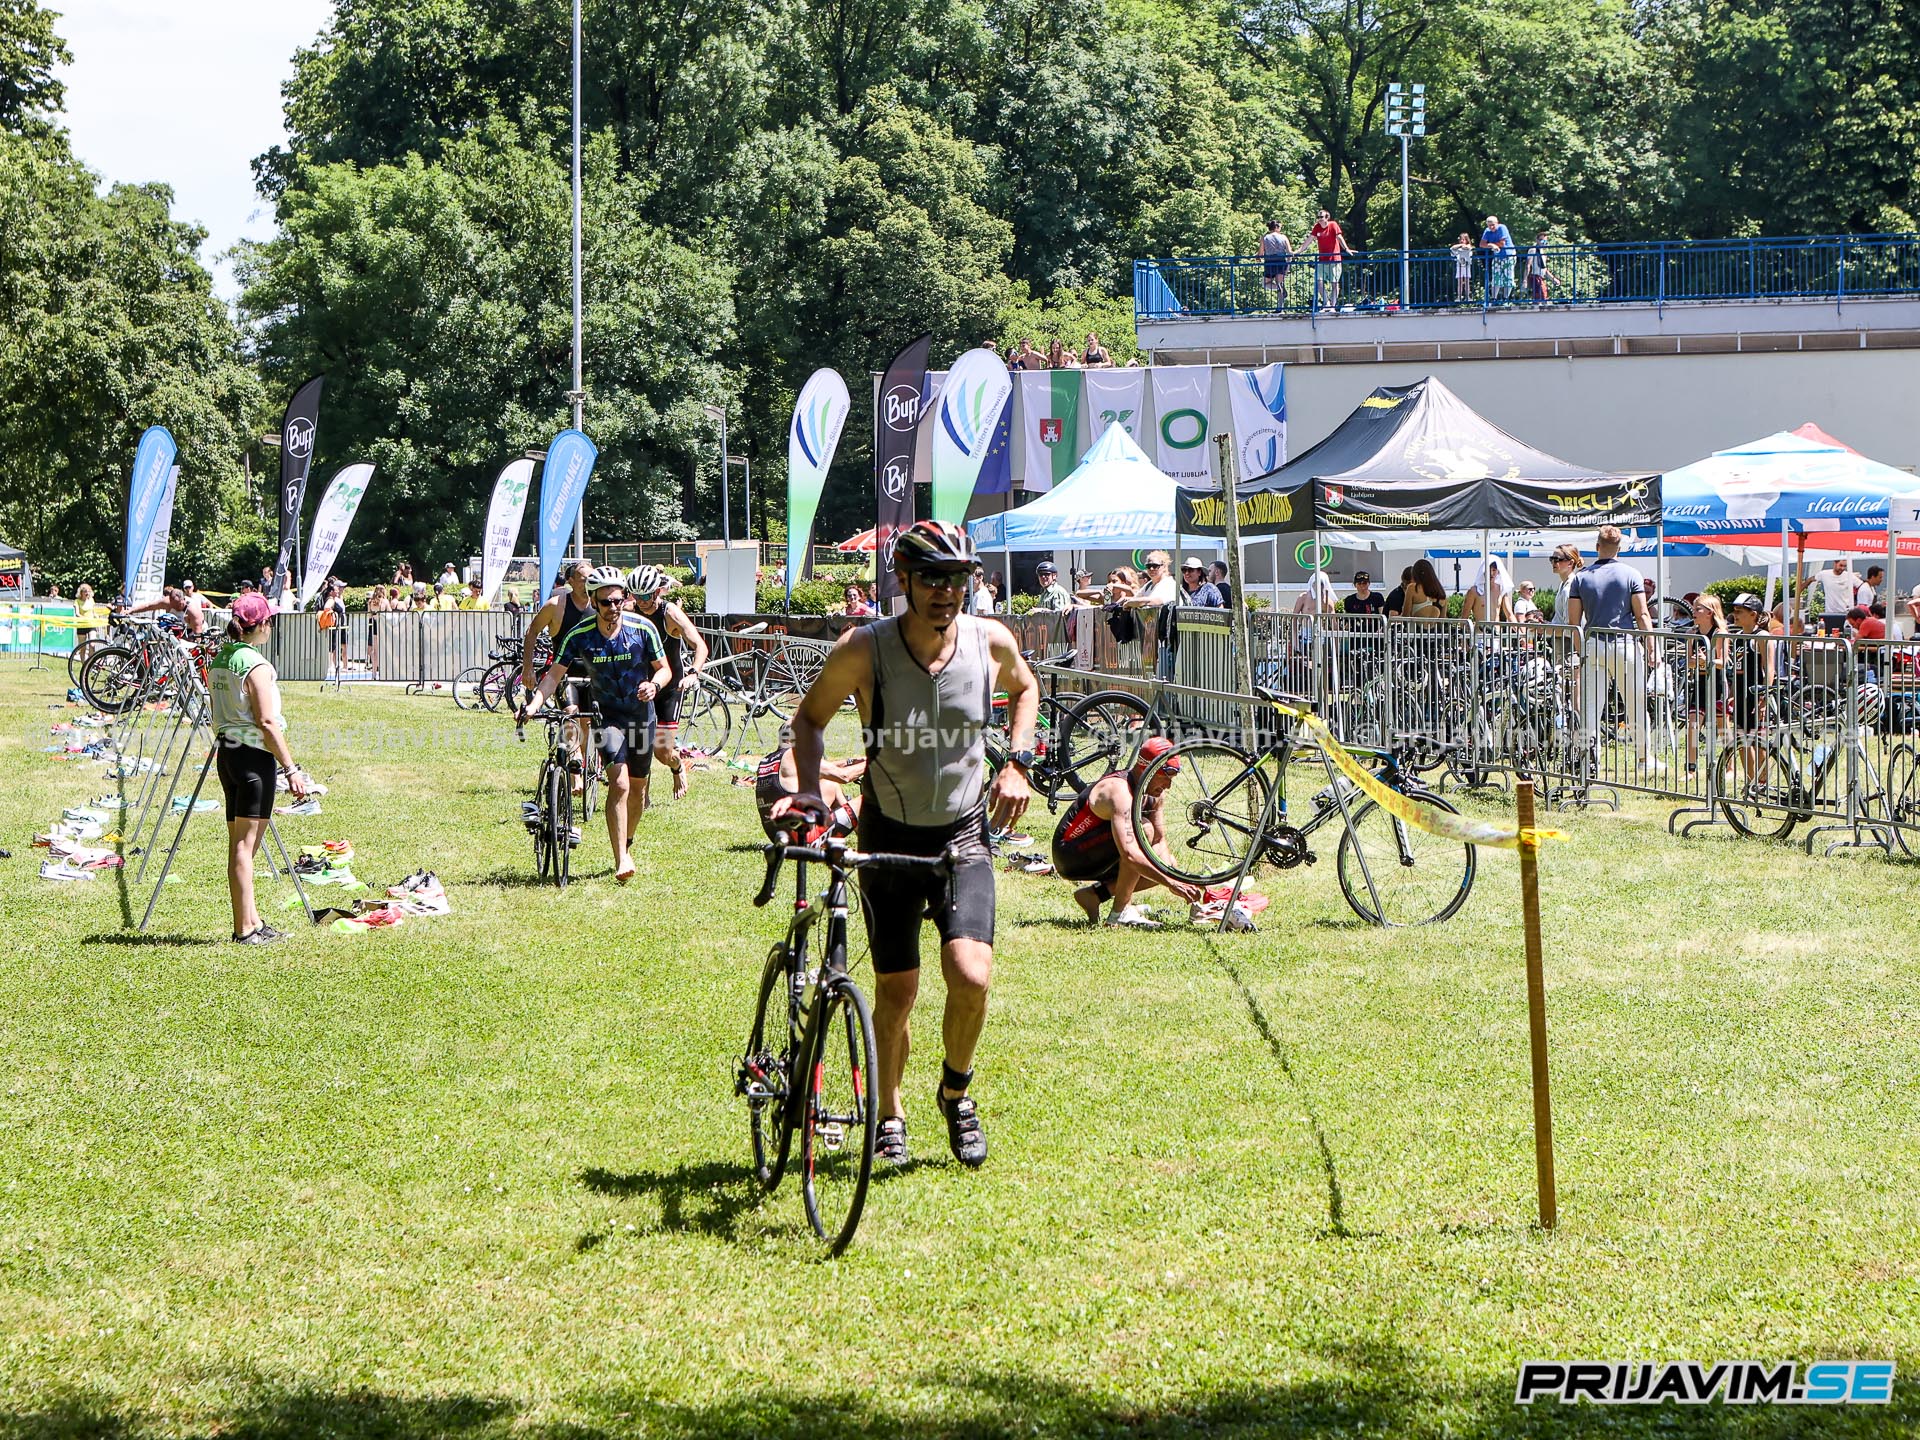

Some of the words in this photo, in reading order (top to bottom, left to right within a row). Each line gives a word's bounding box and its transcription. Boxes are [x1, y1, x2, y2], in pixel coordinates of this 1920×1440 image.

[886, 394, 920, 424] Buff
[287, 425, 315, 452] Buff
[1806, 497, 1887, 513] sladoled
